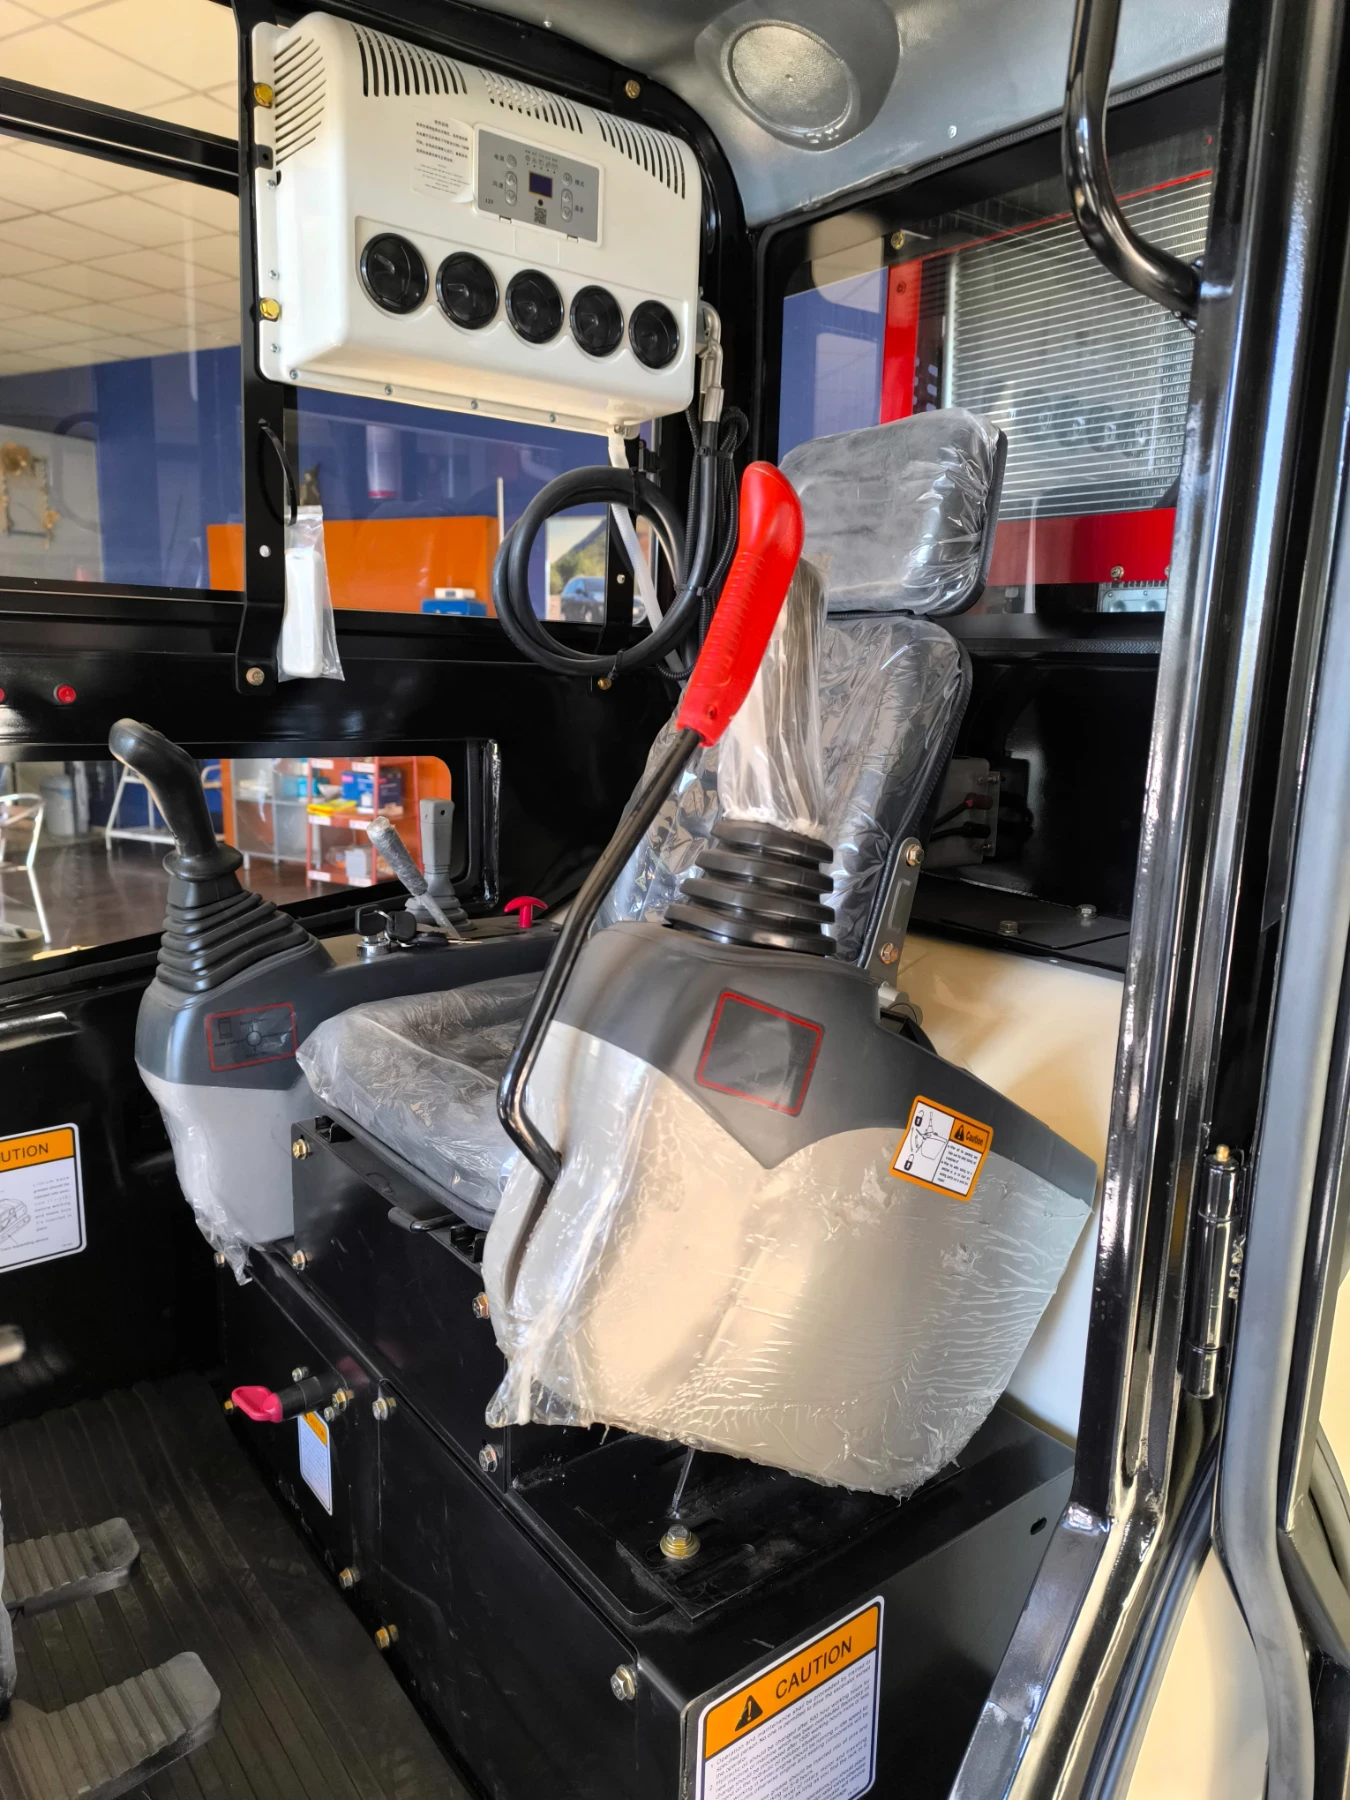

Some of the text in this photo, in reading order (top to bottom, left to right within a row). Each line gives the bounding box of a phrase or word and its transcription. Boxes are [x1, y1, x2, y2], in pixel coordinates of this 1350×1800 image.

[965, 1131, 984, 1146] Caution
[0, 1142, 48, 1163] UTION
[775, 1636, 853, 1700] CAUTION
